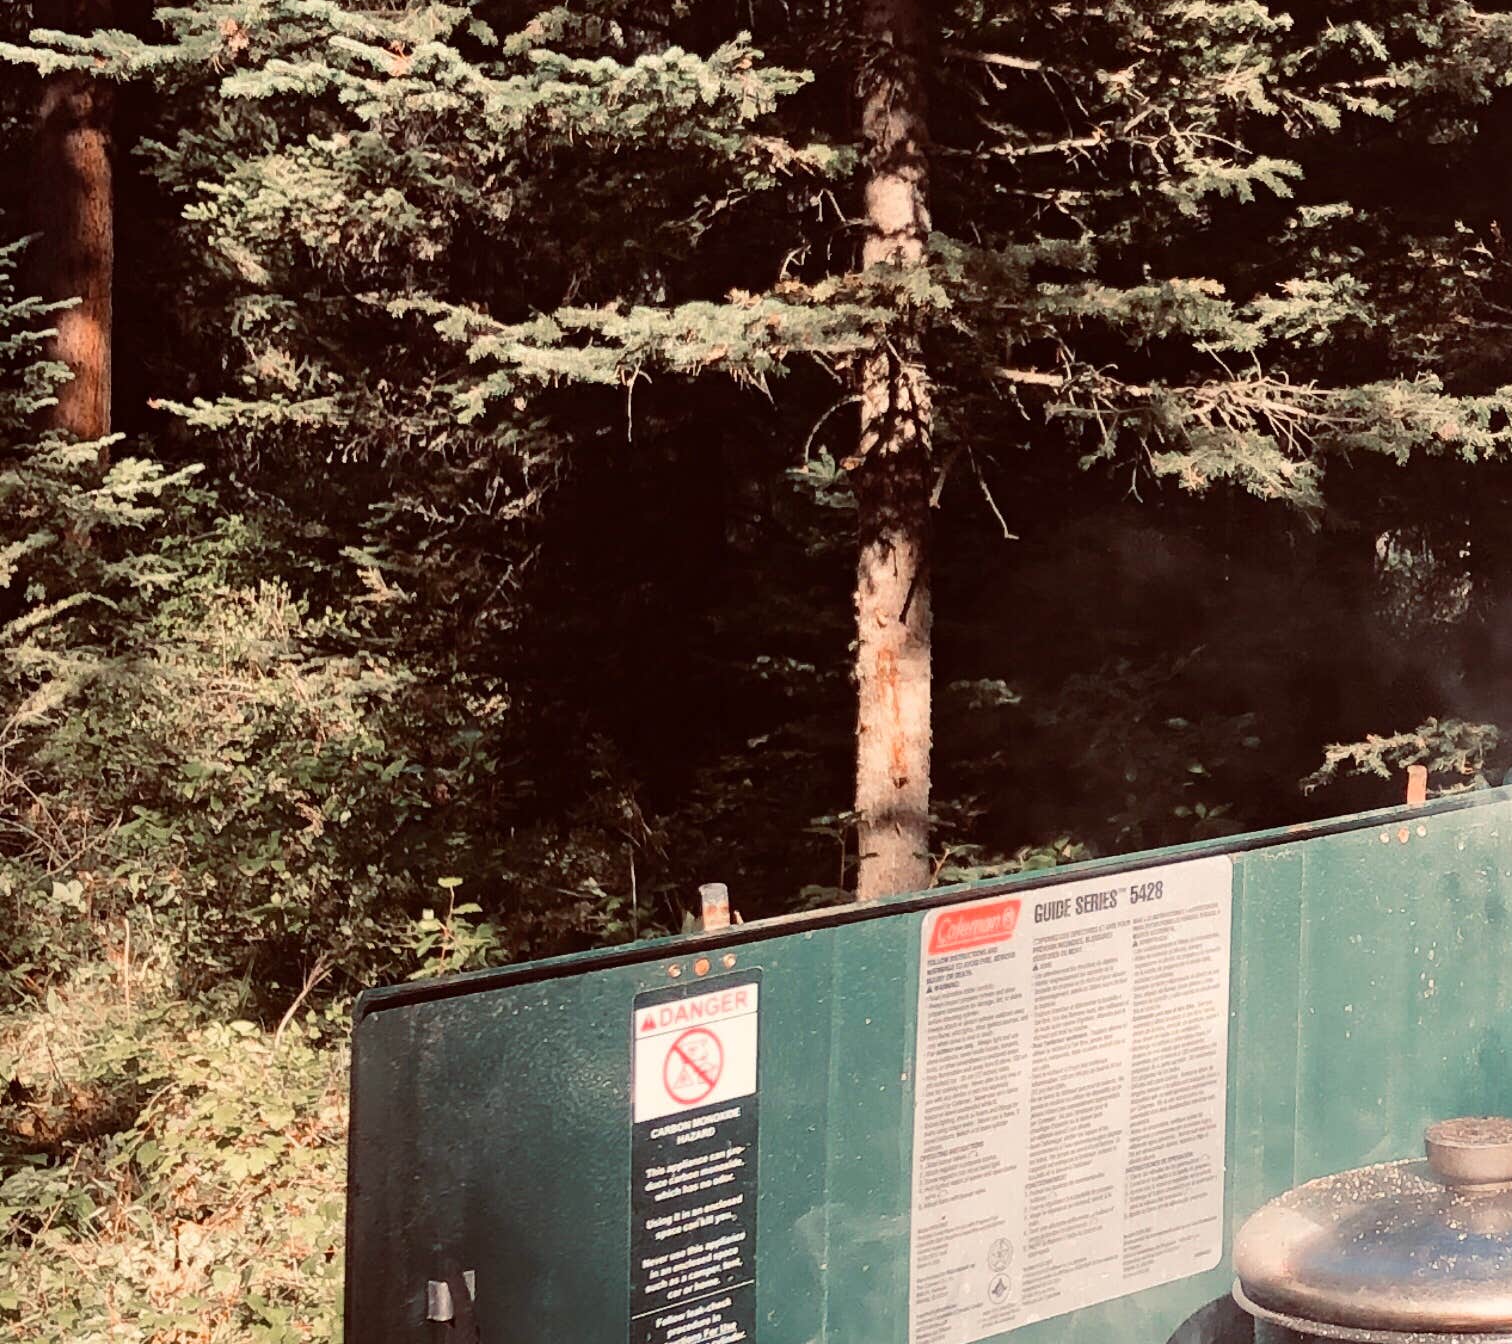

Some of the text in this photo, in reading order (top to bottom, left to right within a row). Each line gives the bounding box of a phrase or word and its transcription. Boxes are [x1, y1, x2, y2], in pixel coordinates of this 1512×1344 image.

[1034, 898, 1072, 924] GUIDE
[1130, 880, 1164, 905] 5428
[660, 990, 748, 1027] DANGER
